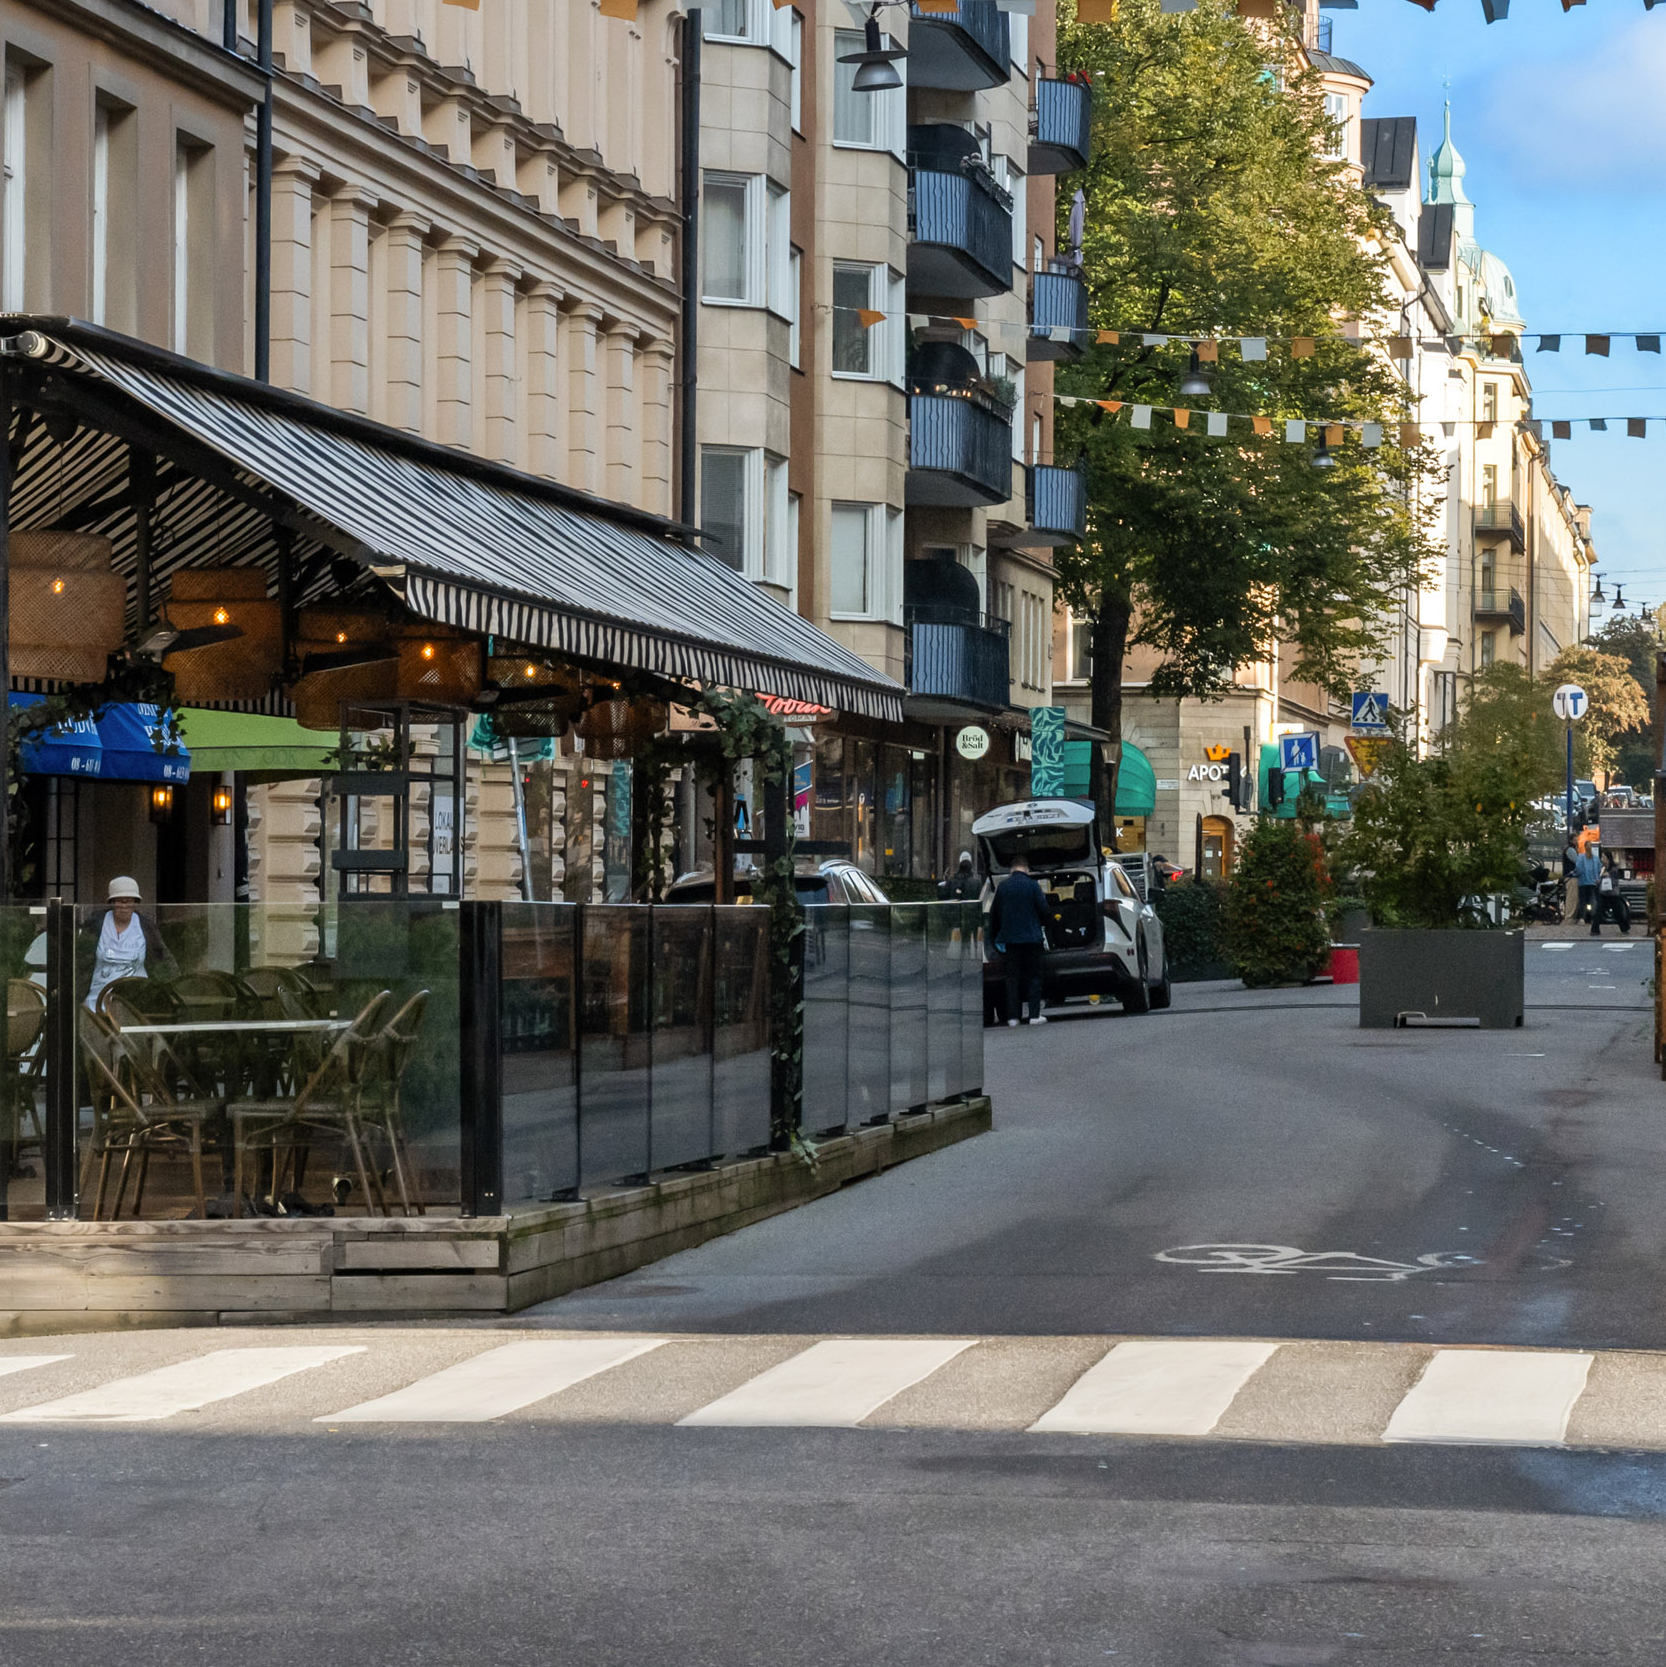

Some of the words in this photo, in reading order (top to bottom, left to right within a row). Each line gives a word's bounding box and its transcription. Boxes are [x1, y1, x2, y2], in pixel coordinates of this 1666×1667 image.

[1570, 692, 1583, 715] T
[962, 734, 983, 742] Bröd
[961, 741, 983, 749] &Salt
[1188, 765, 1247, 781] APOT
